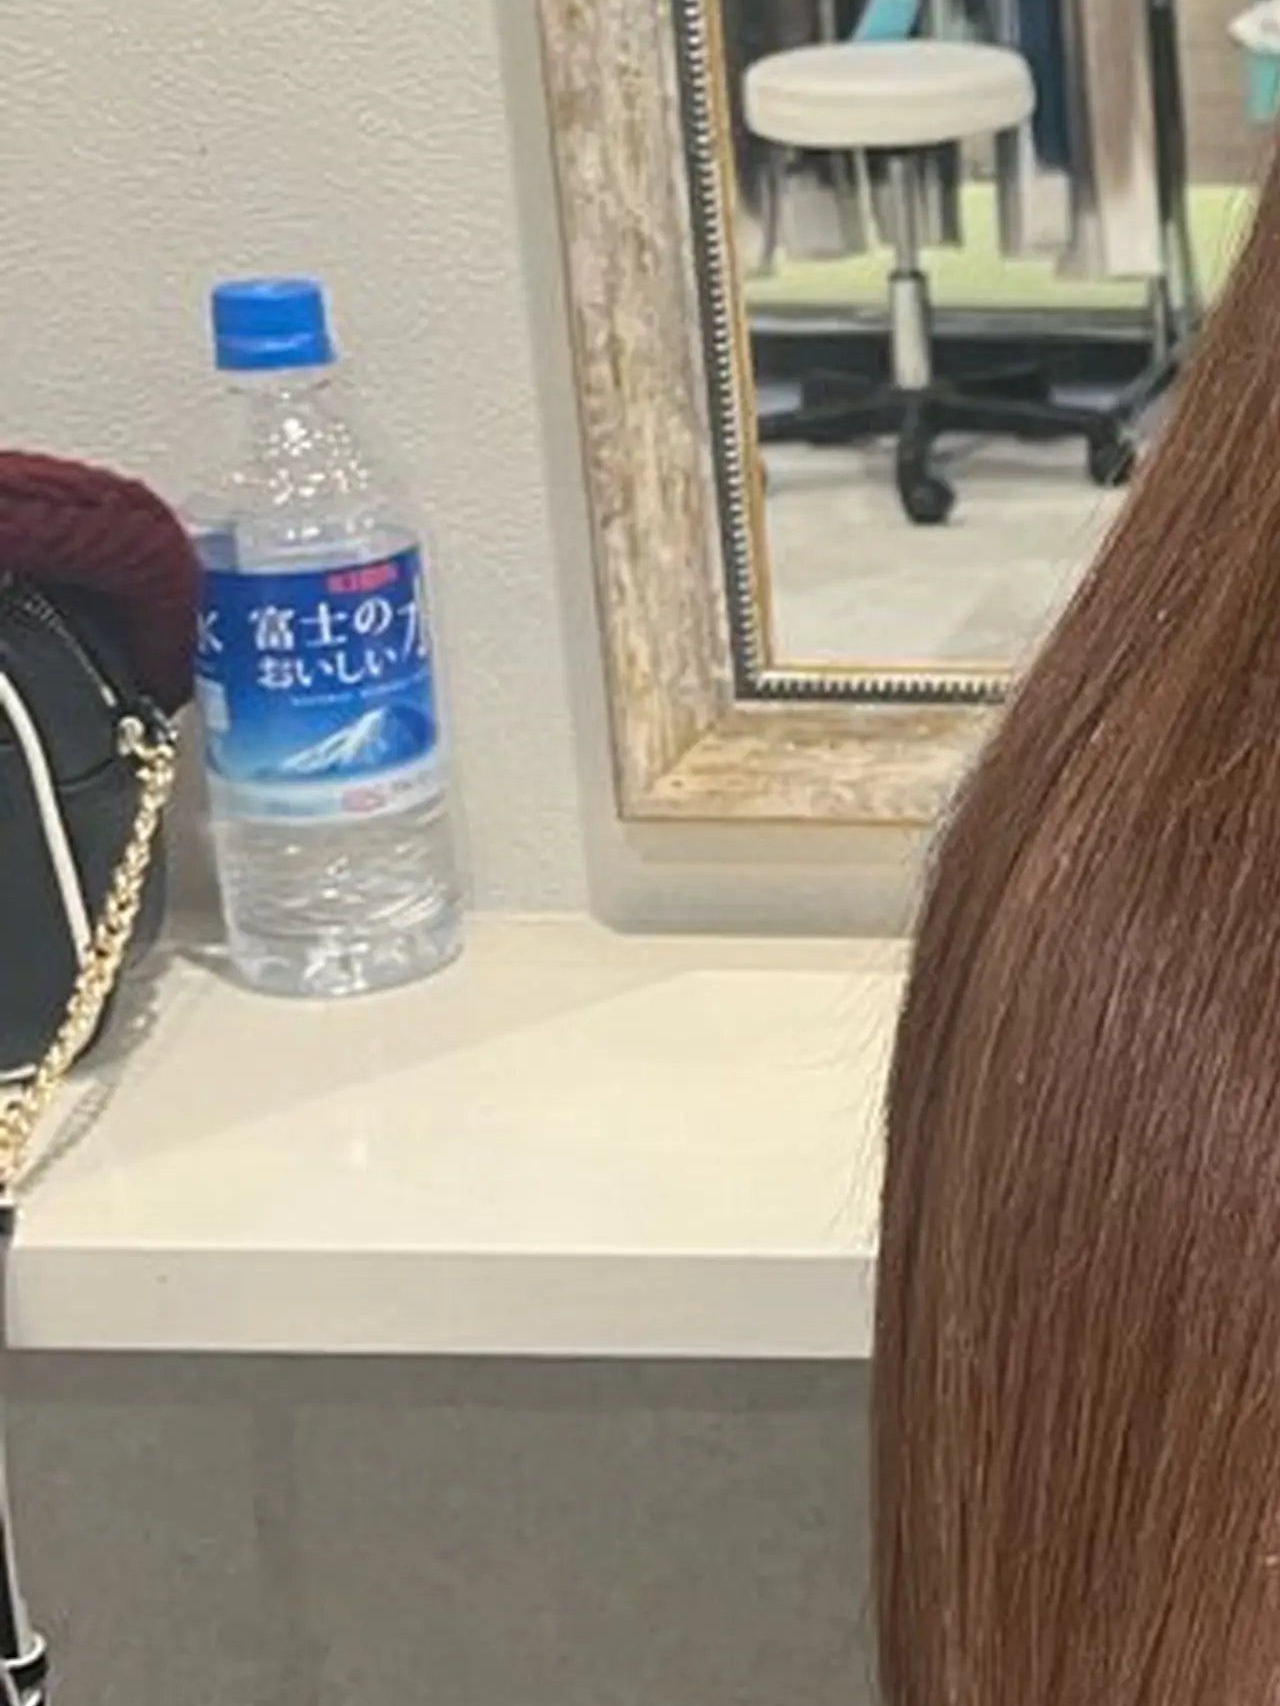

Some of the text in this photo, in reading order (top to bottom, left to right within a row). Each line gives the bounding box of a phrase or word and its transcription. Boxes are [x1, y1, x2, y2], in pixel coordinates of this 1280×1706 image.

[248, 597, 394, 651] 富士の
[256, 647, 398, 689] おいしい
